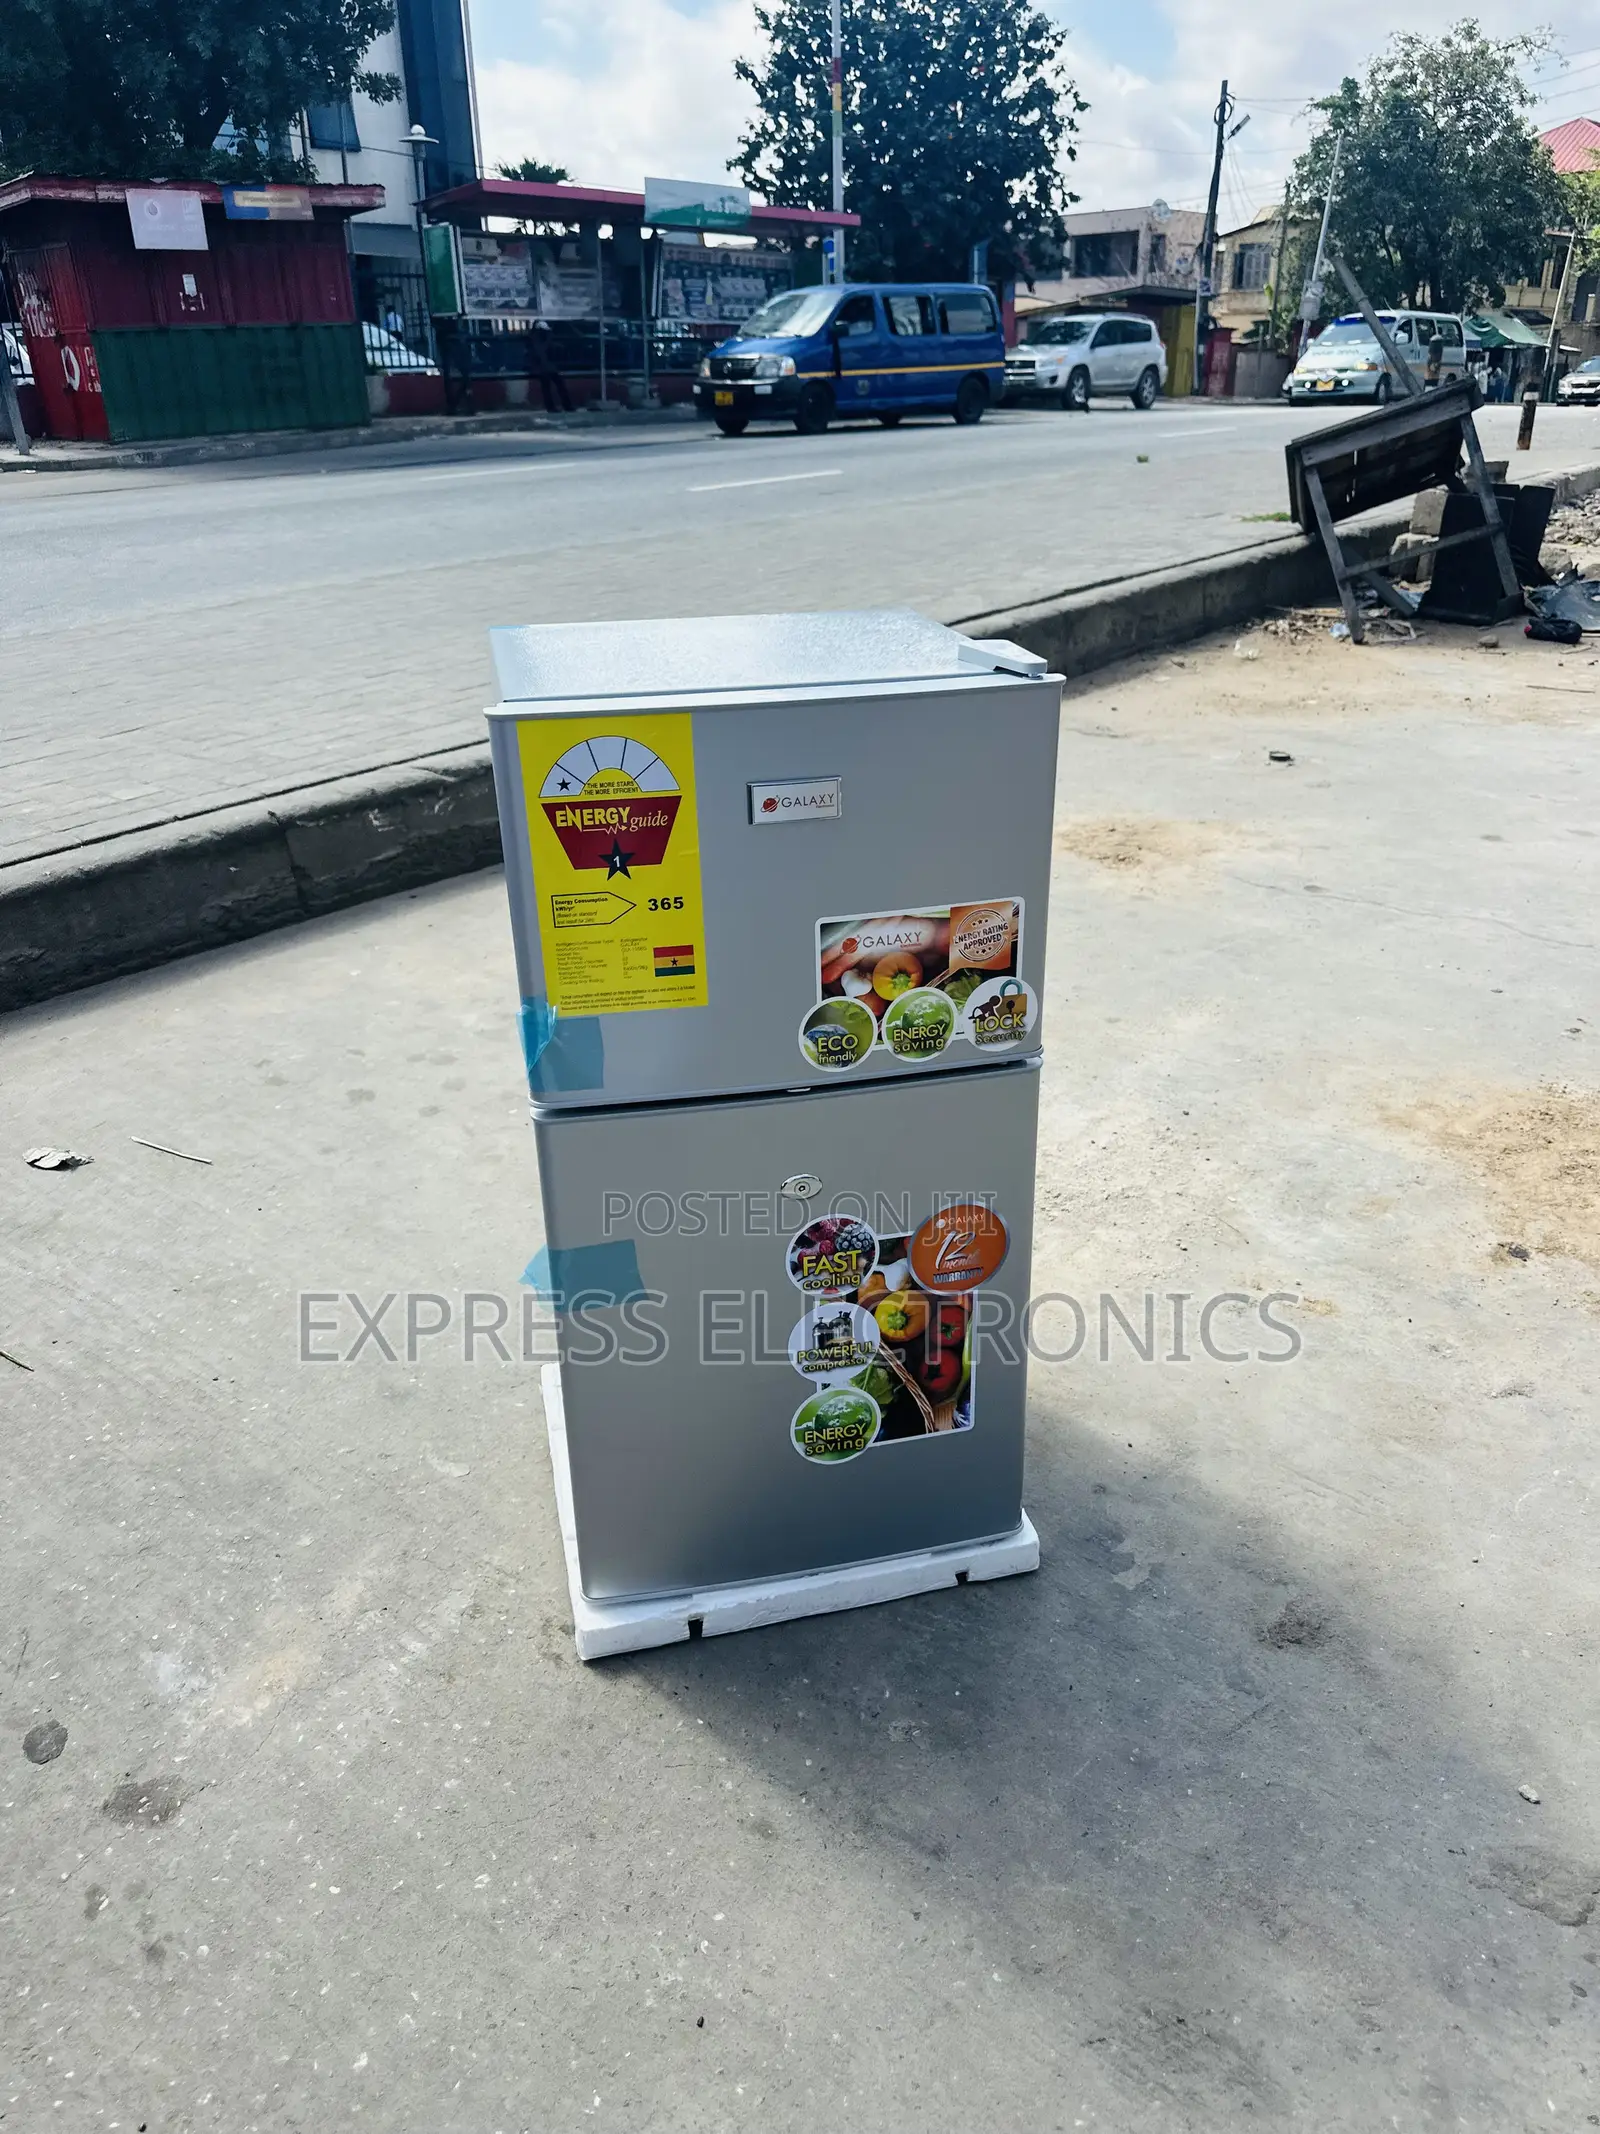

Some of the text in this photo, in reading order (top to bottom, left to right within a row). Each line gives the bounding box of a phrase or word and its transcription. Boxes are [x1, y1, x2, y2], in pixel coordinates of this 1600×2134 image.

[781, 793, 835, 808] GALAXY
[555, 804, 631, 832] ENERGY
[629, 810, 669, 833] guide
[613, 855, 621, 868] 1
[647, 896, 684, 912] 365
[862, 931, 923, 949] GALAXY
[954, 922, 1009, 945] ENERGY RATING
[963, 933, 1003, 951] APPROVED
[974, 1012, 1025, 1034] LOCK
[892, 1023, 946, 1042] ENERGY
[974, 1029, 1027, 1046] Security
[816, 1033, 859, 1053] ECO
[893, 1037, 945, 1056] saving
[817, 1050, 858, 1066] friendly
[948, 1212, 985, 1225] GALAXY
[935, 1231, 976, 1270] 12
[803, 1249, 862, 1277] FAST
[803, 1274, 861, 1290] cooling
[933, 1267, 984, 1284] WARRANTY
[797, 1341, 877, 1363] POWERFUL
[802, 1357, 868, 1373] compressor
[804, 1423, 867, 1444] ENERGY
[805, 1438, 866, 1456] saving
